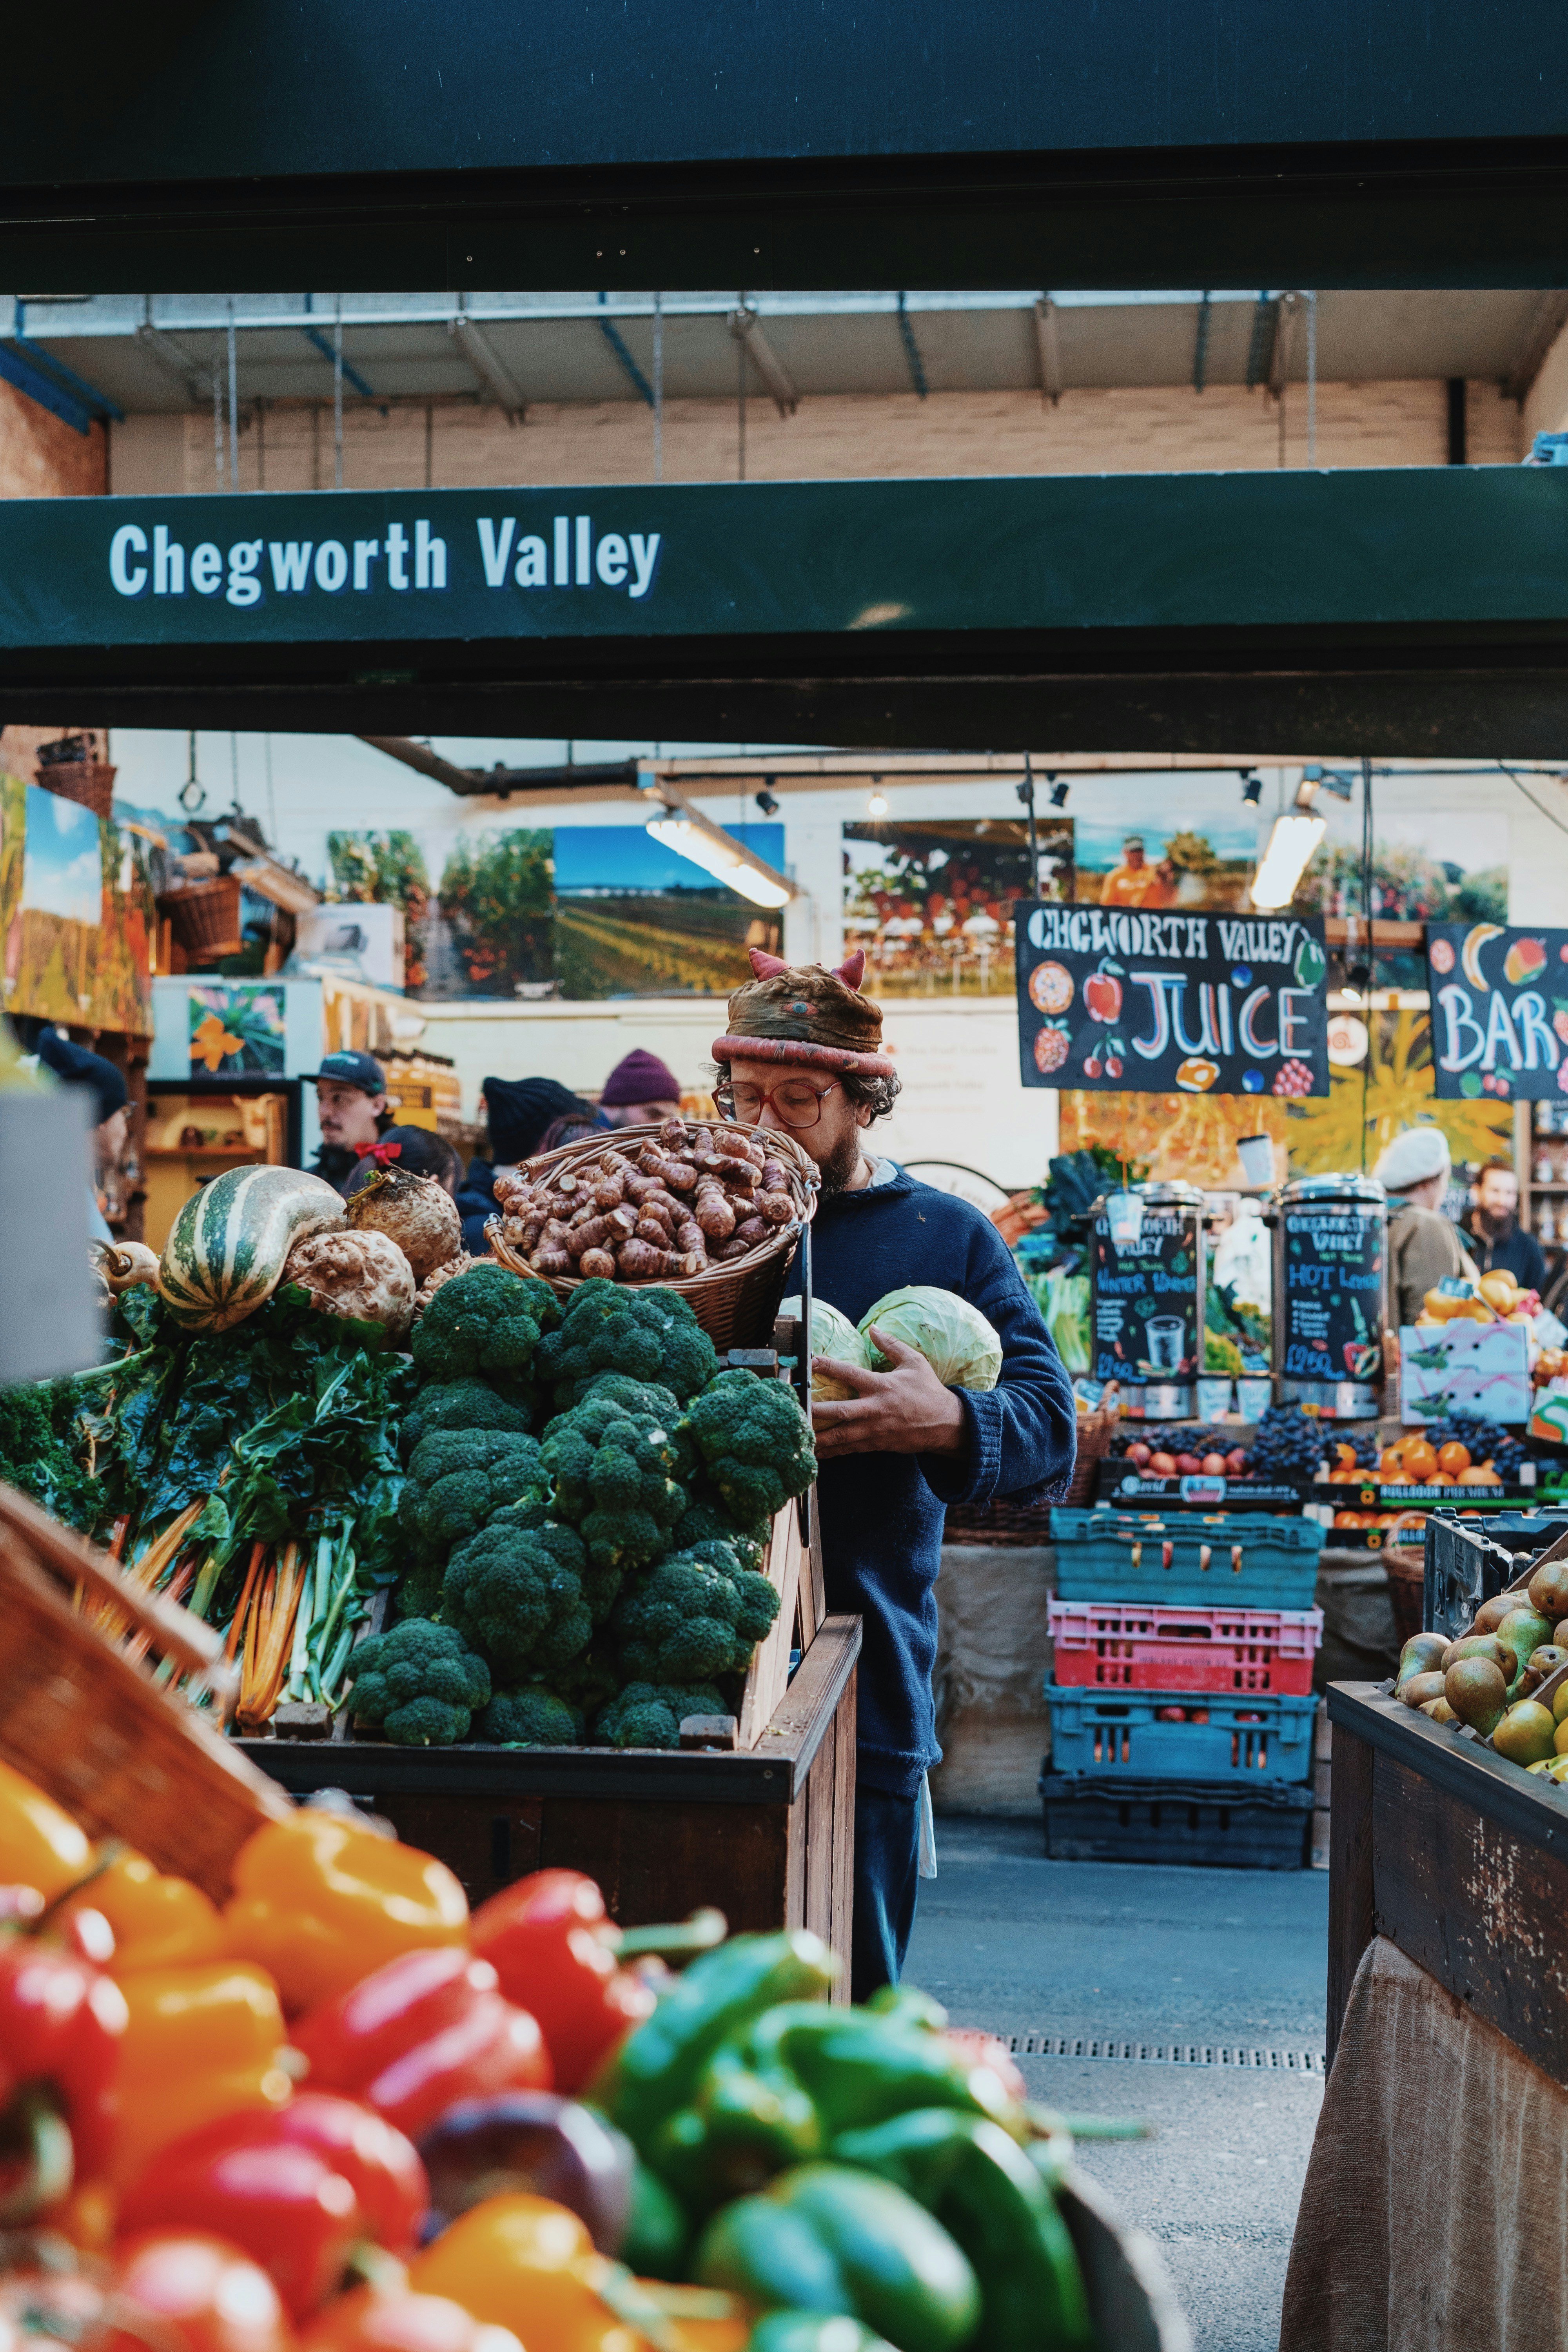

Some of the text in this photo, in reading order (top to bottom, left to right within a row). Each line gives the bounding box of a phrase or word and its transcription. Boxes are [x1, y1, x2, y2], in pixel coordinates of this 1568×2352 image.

[109, 515, 661, 606] Chegworth Valley
[1216, 919, 1300, 965] VALLEY
[1130, 971, 1314, 1060] JUICE
[1437, 984, 1559, 1073] BAR
[1289, 1264, 1335, 1290] HOT
